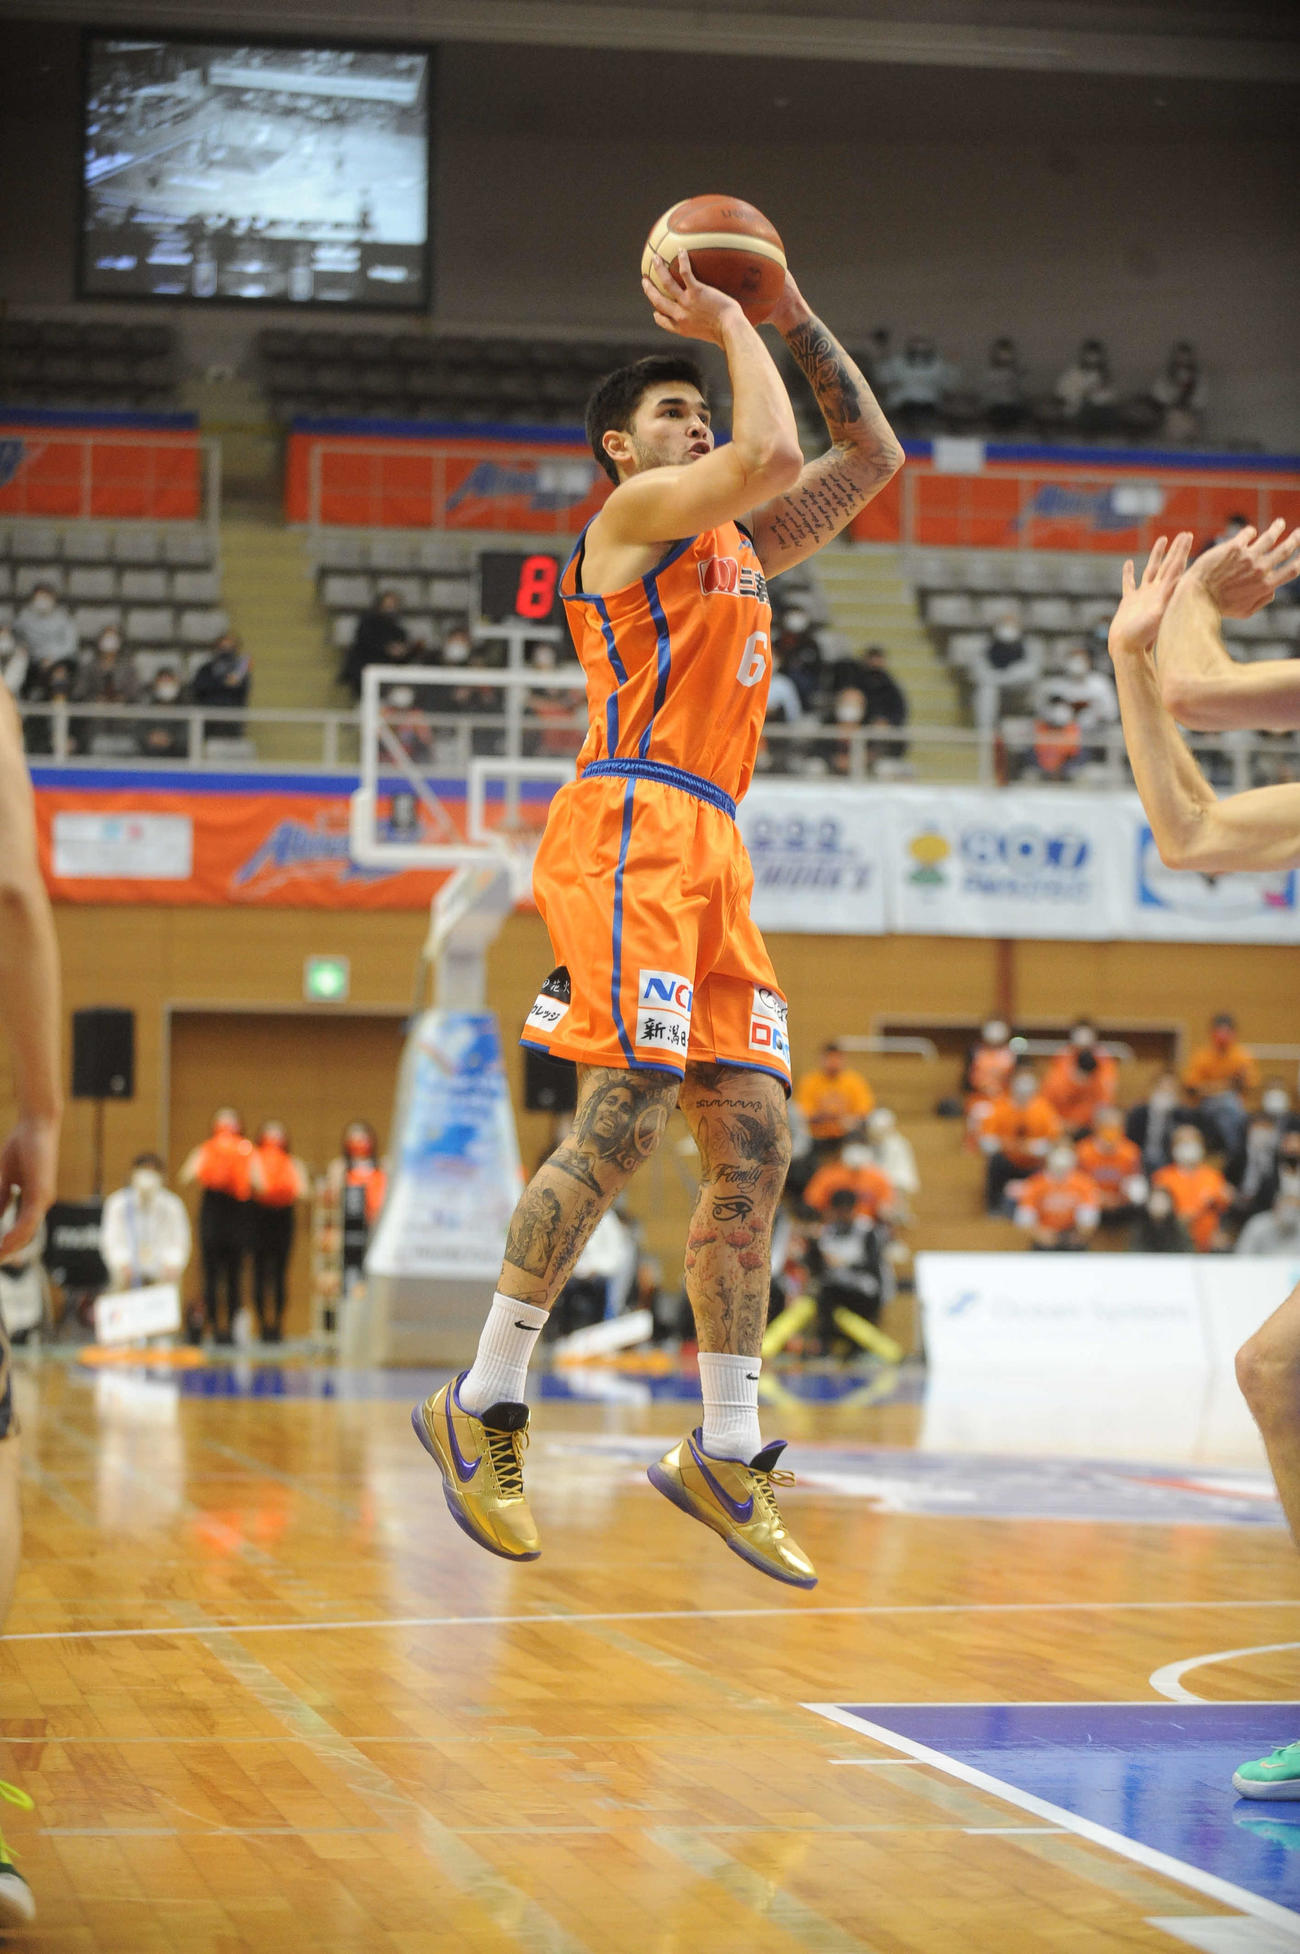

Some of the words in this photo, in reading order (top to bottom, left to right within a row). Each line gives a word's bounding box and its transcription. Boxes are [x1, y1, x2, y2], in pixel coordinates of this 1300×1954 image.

[515, 555, 558, 619] 8
[736, 630, 768, 688] 6
[641, 1018, 689, 1047] 新潟日
[715, 1163, 762, 1194] Family
